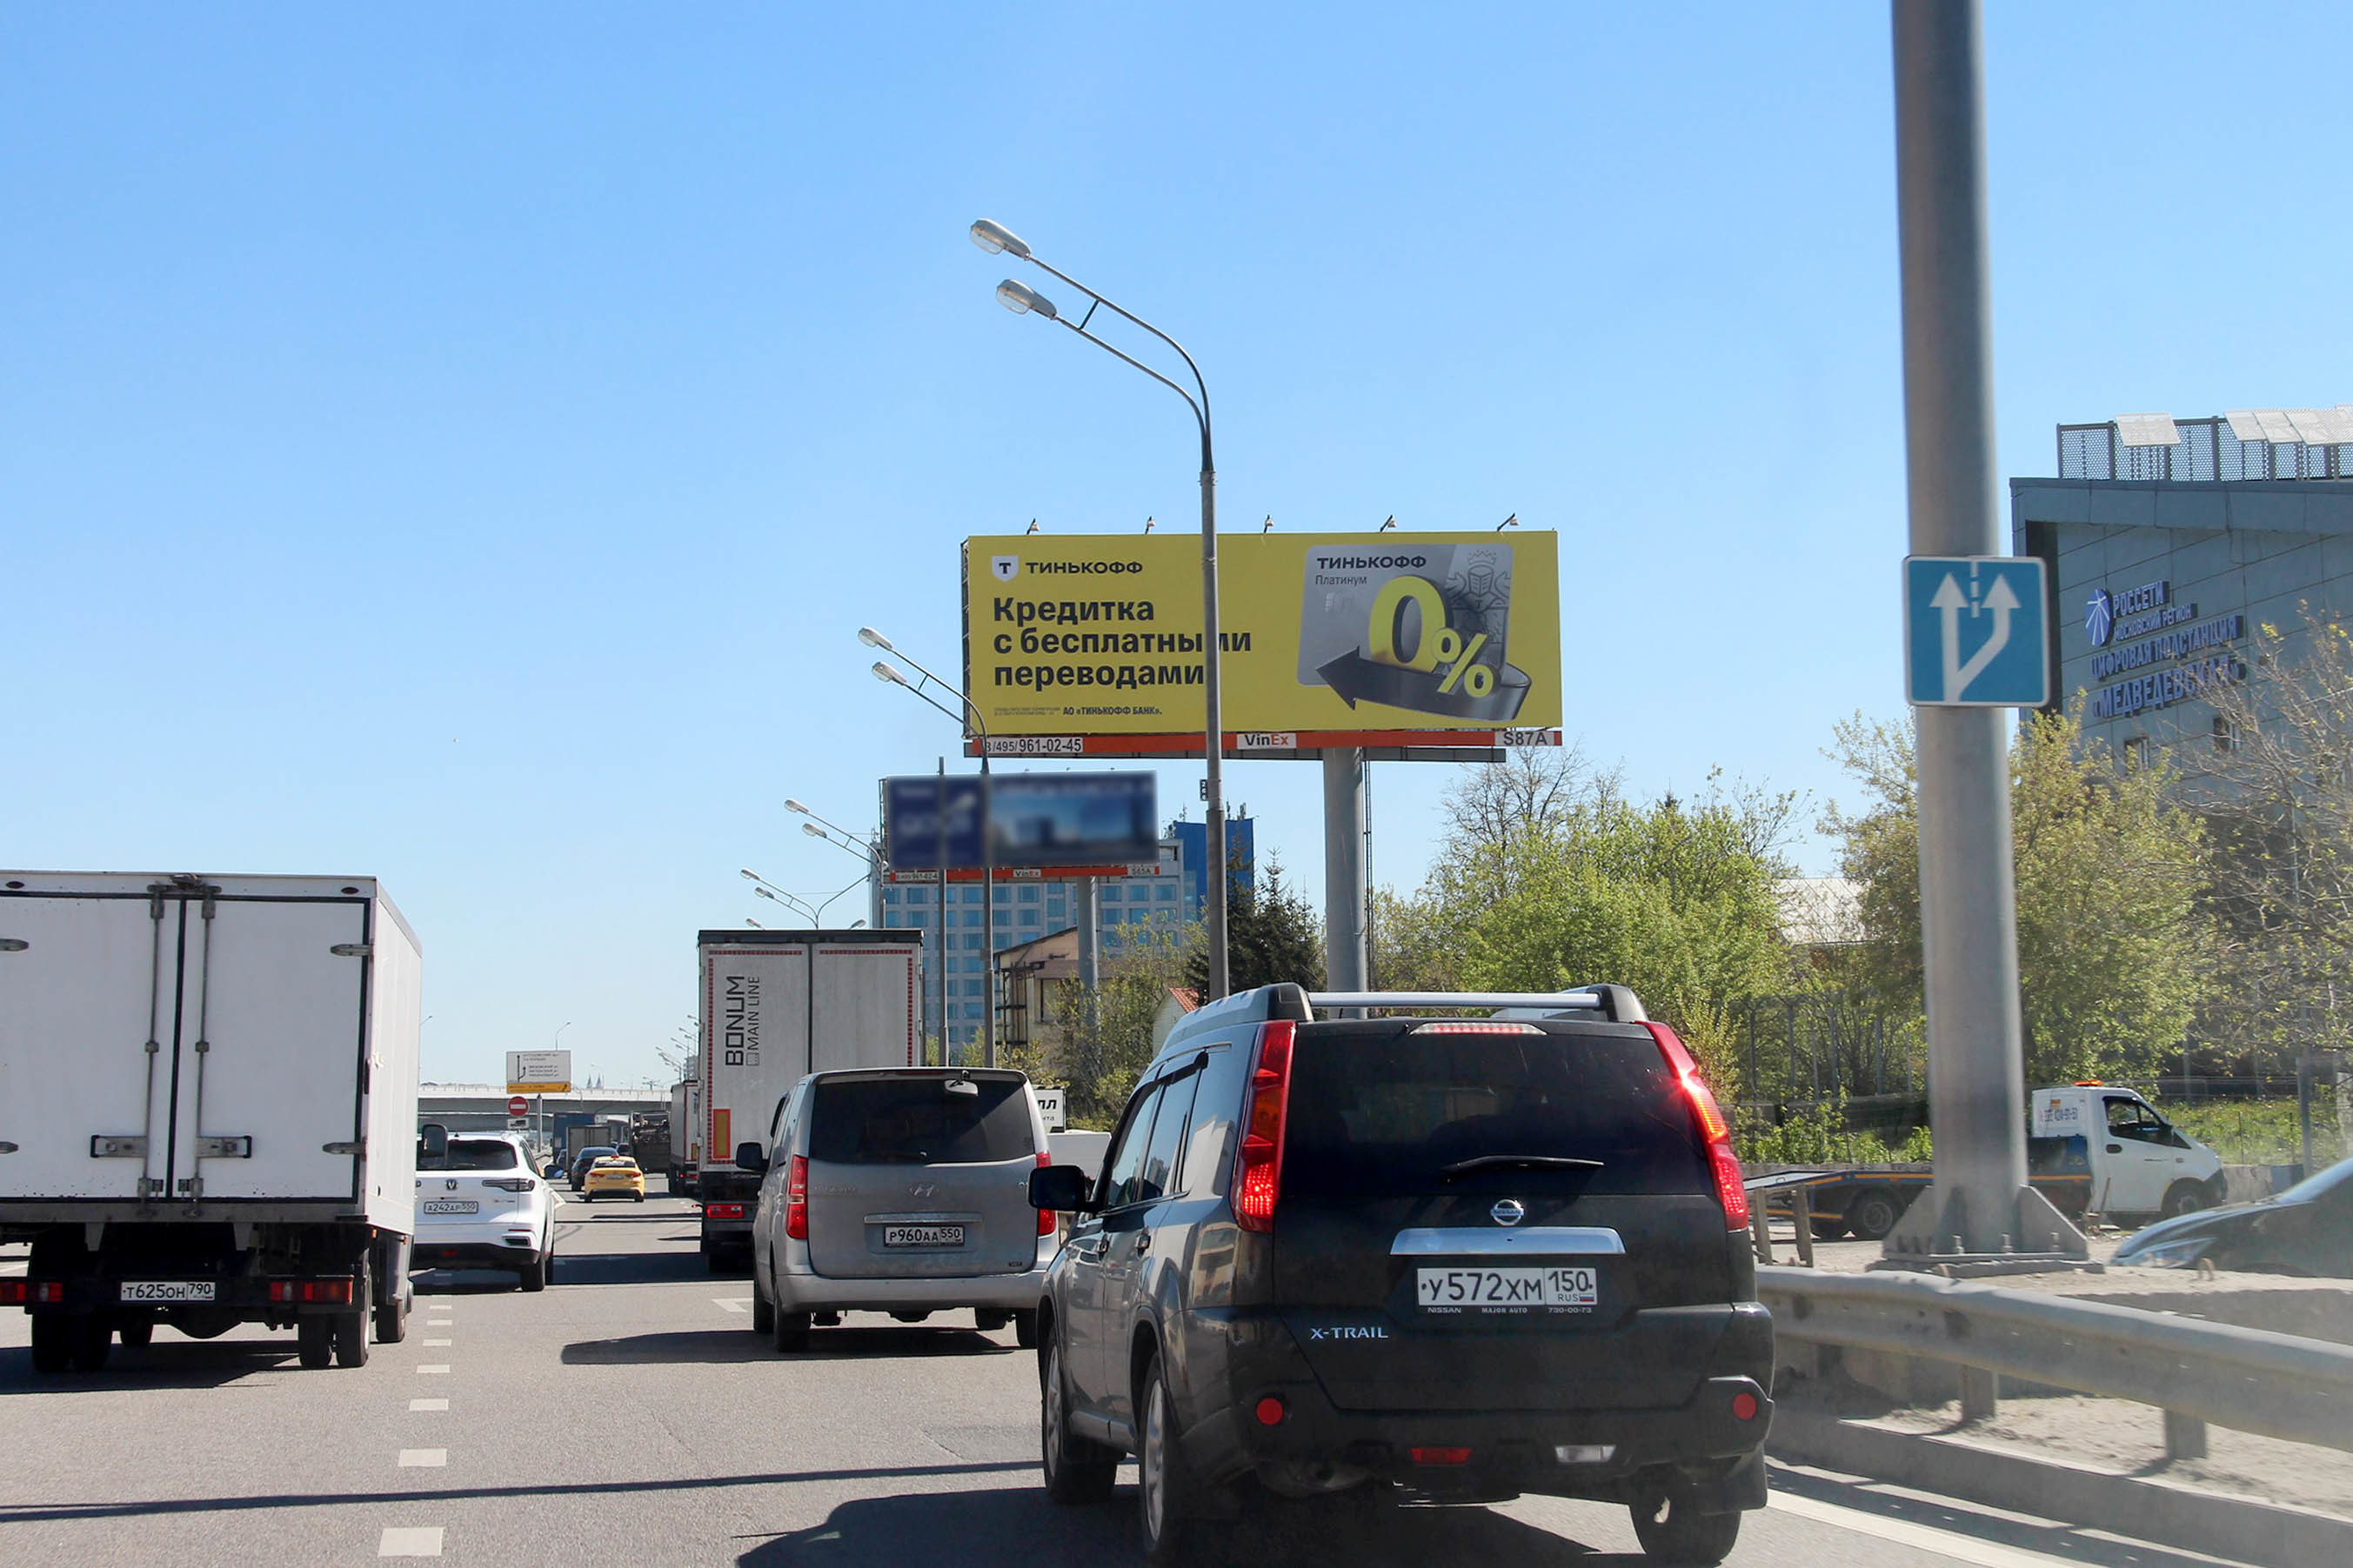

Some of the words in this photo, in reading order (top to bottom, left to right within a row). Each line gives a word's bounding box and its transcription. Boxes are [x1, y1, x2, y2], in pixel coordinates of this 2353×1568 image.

[1025, 561, 1144, 574] ТИНЬКОФФ
[1317, 555, 1427, 570] ТИНЬКОФФ
[1314, 574, 1367, 586] Платинум
[2113, 581, 2164, 618] РОССЕТИ
[993, 597, 1155, 627] Кредитка
[993, 632, 1013, 654] с
[994, 664, 1204, 692] переводами
[1063, 707, 1074, 716] АО
[1244, 733, 1289, 746] VinEx
[1502, 731, 1547, 746] S87A
[747, 976, 760, 1006] LINE
[725, 976, 745, 1066] BONUM
[747, 1011, 760, 1050] MAIN
[890, 1229, 939, 1242] Р960АА
[940, 1228, 960, 1238] 550
[126, 1284, 185, 1298] Т625ОН
[189, 1283, 211, 1295] 790
[1428, 1272, 1542, 1301] У572ХМ
[1548, 1271, 1589, 1292] 150
[1557, 1293, 1579, 1302] RUS
[1310, 1326, 1389, 1340] X-TRAIL
